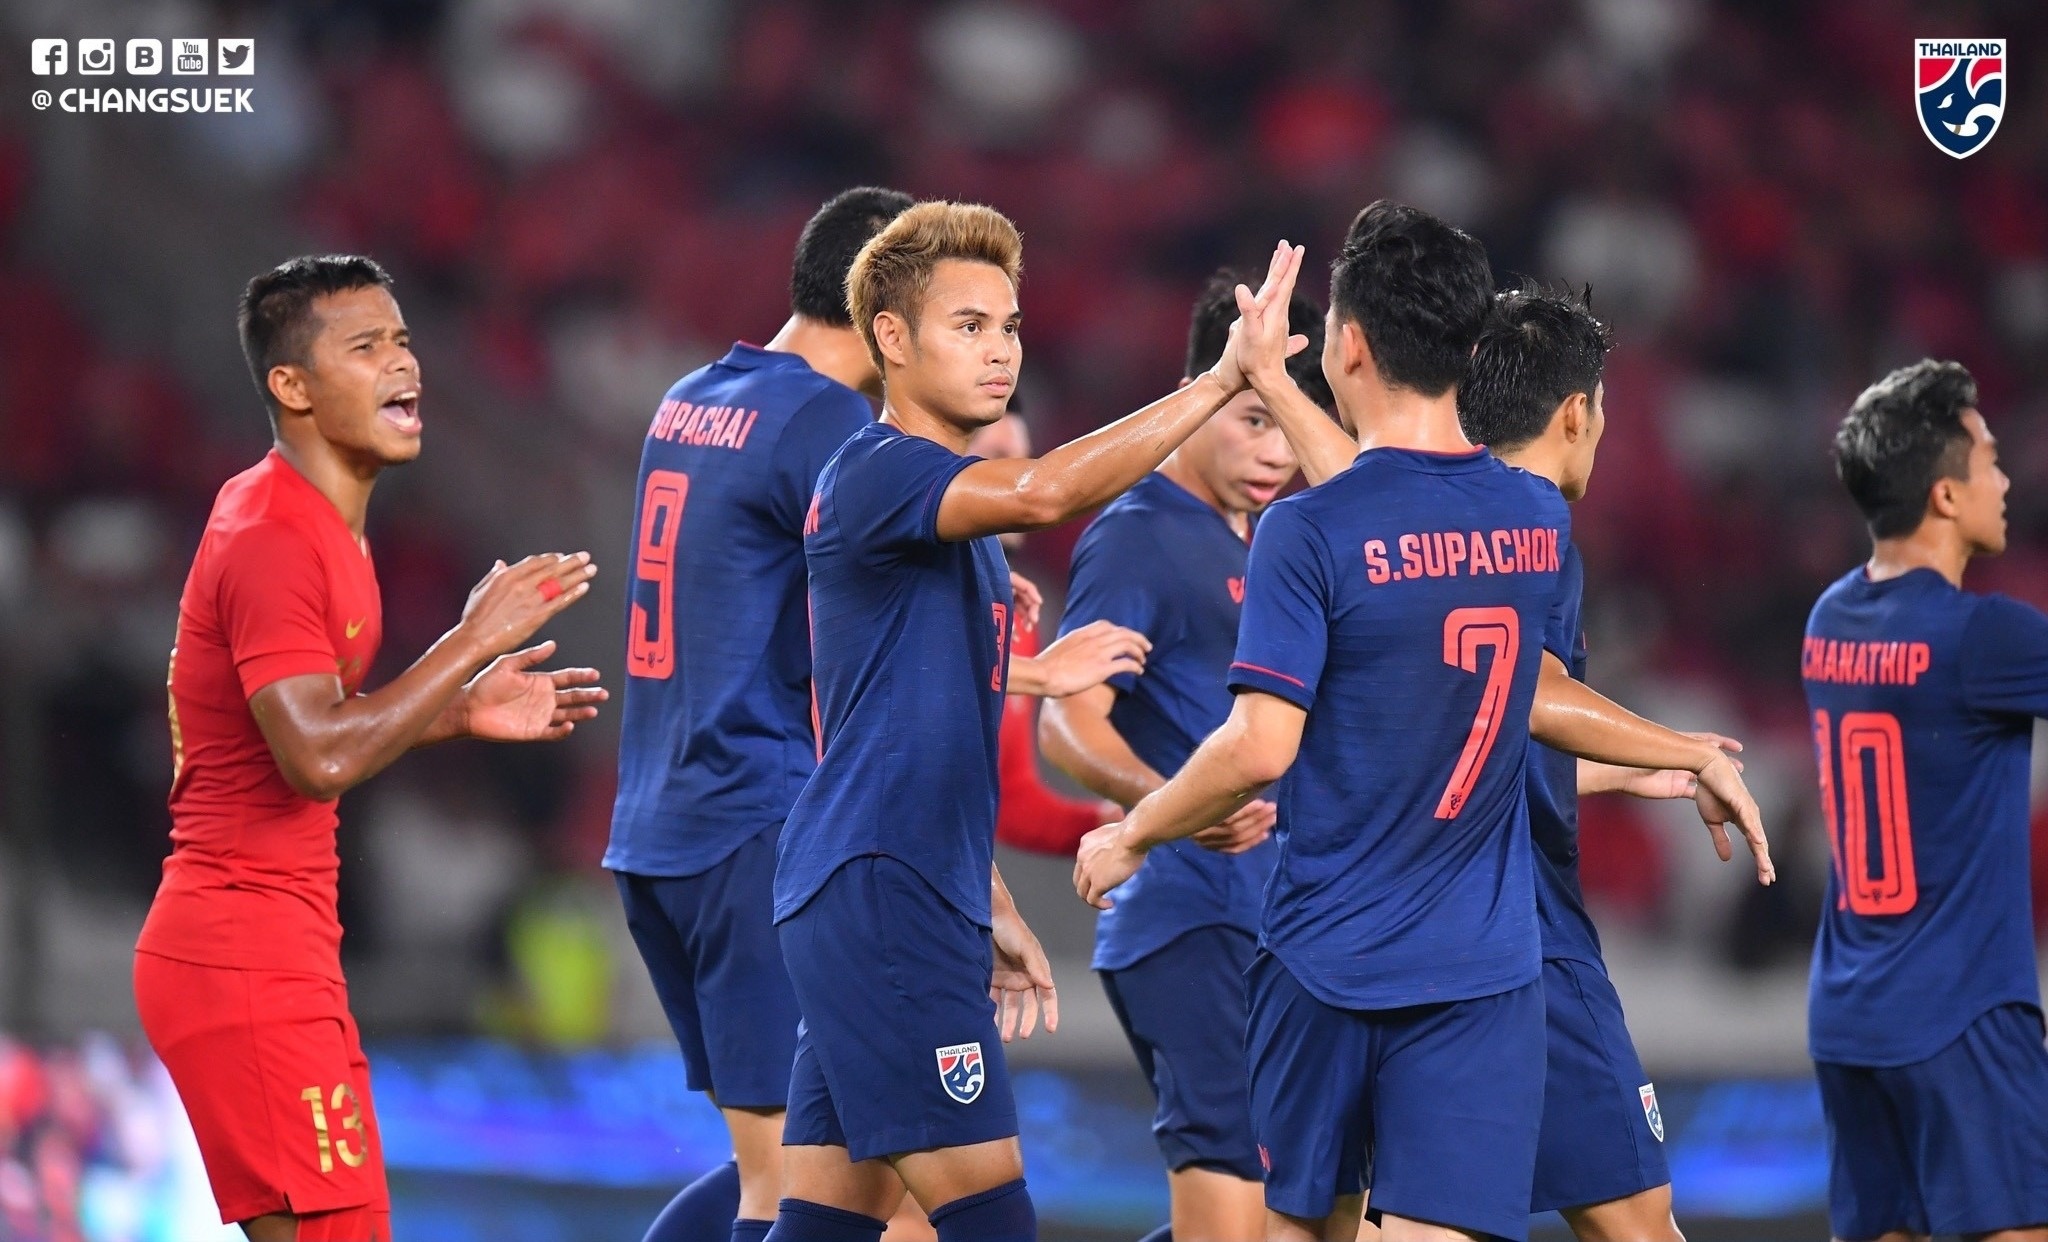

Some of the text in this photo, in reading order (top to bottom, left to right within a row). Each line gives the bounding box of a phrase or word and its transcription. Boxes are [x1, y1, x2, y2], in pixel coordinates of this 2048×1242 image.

[649, 399, 758, 450] SUPACHAI
[626, 468, 689, 680] 9
[1363, 527, 1560, 585] S.SUPACHOK
[990, 602, 1008, 692] 3
[1802, 635, 1930, 686] CHANATHIP
[1433, 605, 1519, 820] 7
[1814, 708, 1918, 916] 10
[938, 1045, 978, 1057] THAILAND
[300, 1082, 368, 1173] 13
